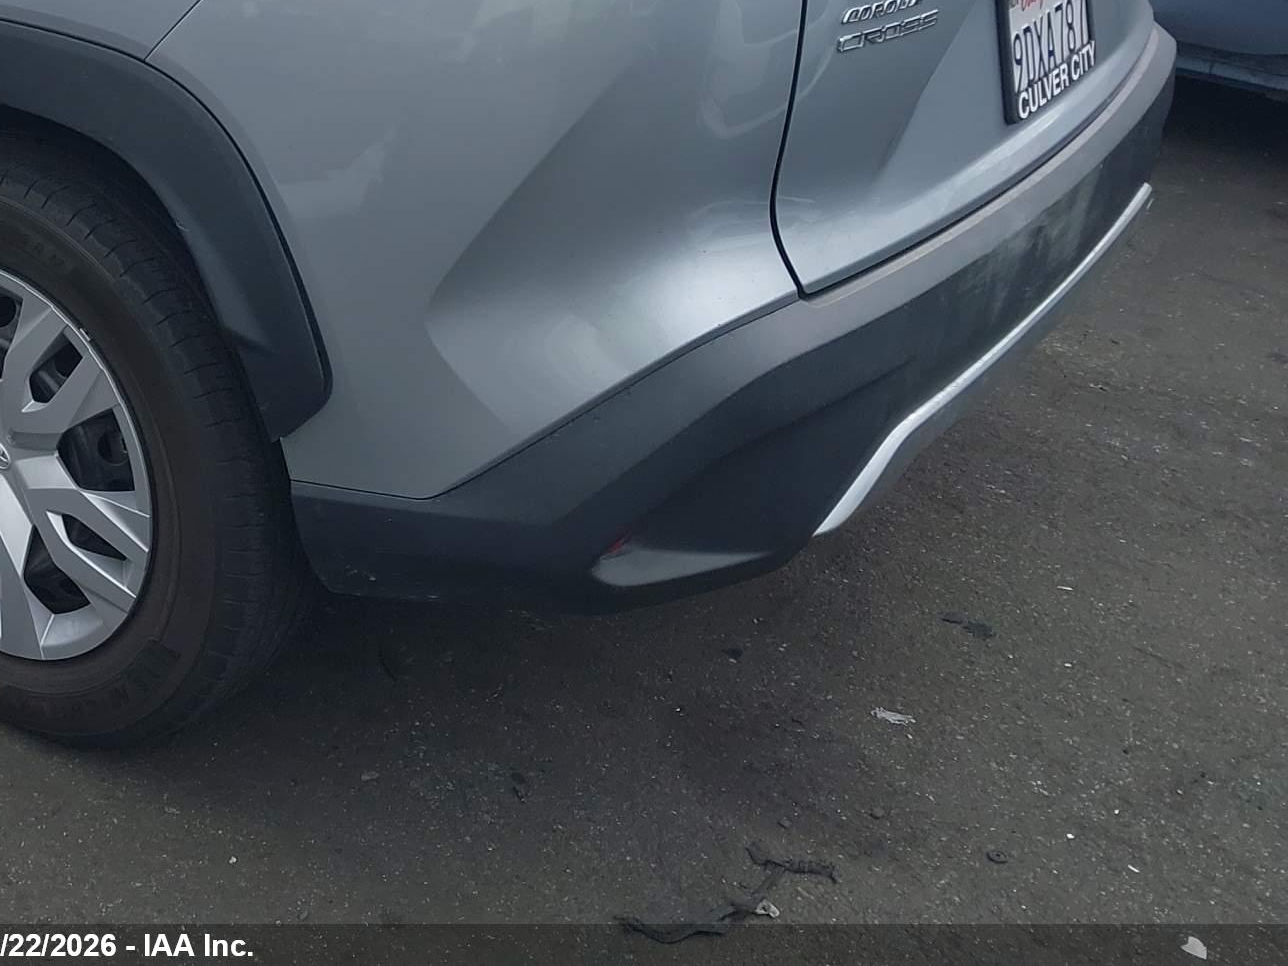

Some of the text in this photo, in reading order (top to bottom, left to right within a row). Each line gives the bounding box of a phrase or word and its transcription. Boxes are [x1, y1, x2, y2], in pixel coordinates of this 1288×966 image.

[837, 9, 939, 52] CROSS
[1018, 39, 1096, 119] CULVER CITY
